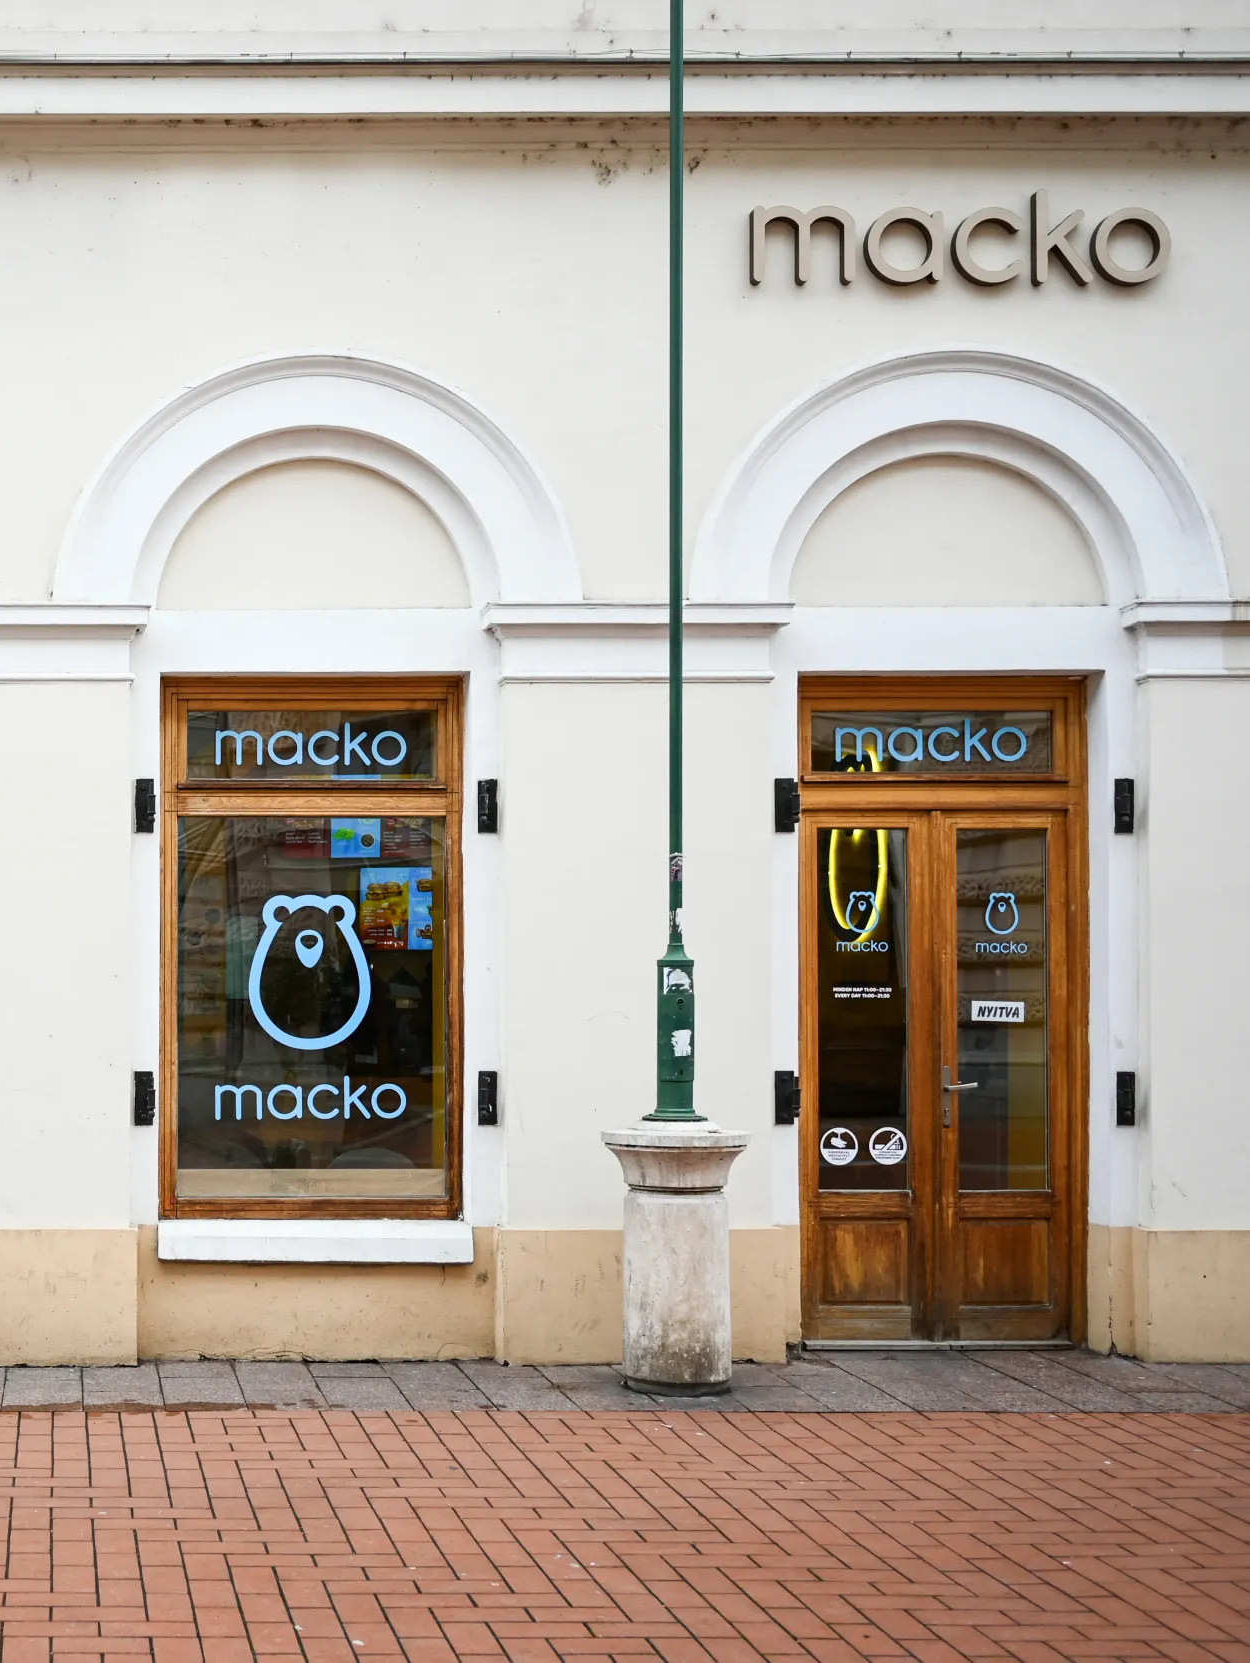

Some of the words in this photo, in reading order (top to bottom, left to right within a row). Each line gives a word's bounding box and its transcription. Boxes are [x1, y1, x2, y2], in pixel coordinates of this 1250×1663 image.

[748, 188, 1172, 288] macko
[215, 722, 407, 767] macko
[835, 718, 1028, 763] macko
[836, 940, 889, 952] macko
[975, 941, 1028, 954] macko
[977, 1005, 1019, 1018] NYITVA
[214, 1075, 407, 1120] macko
